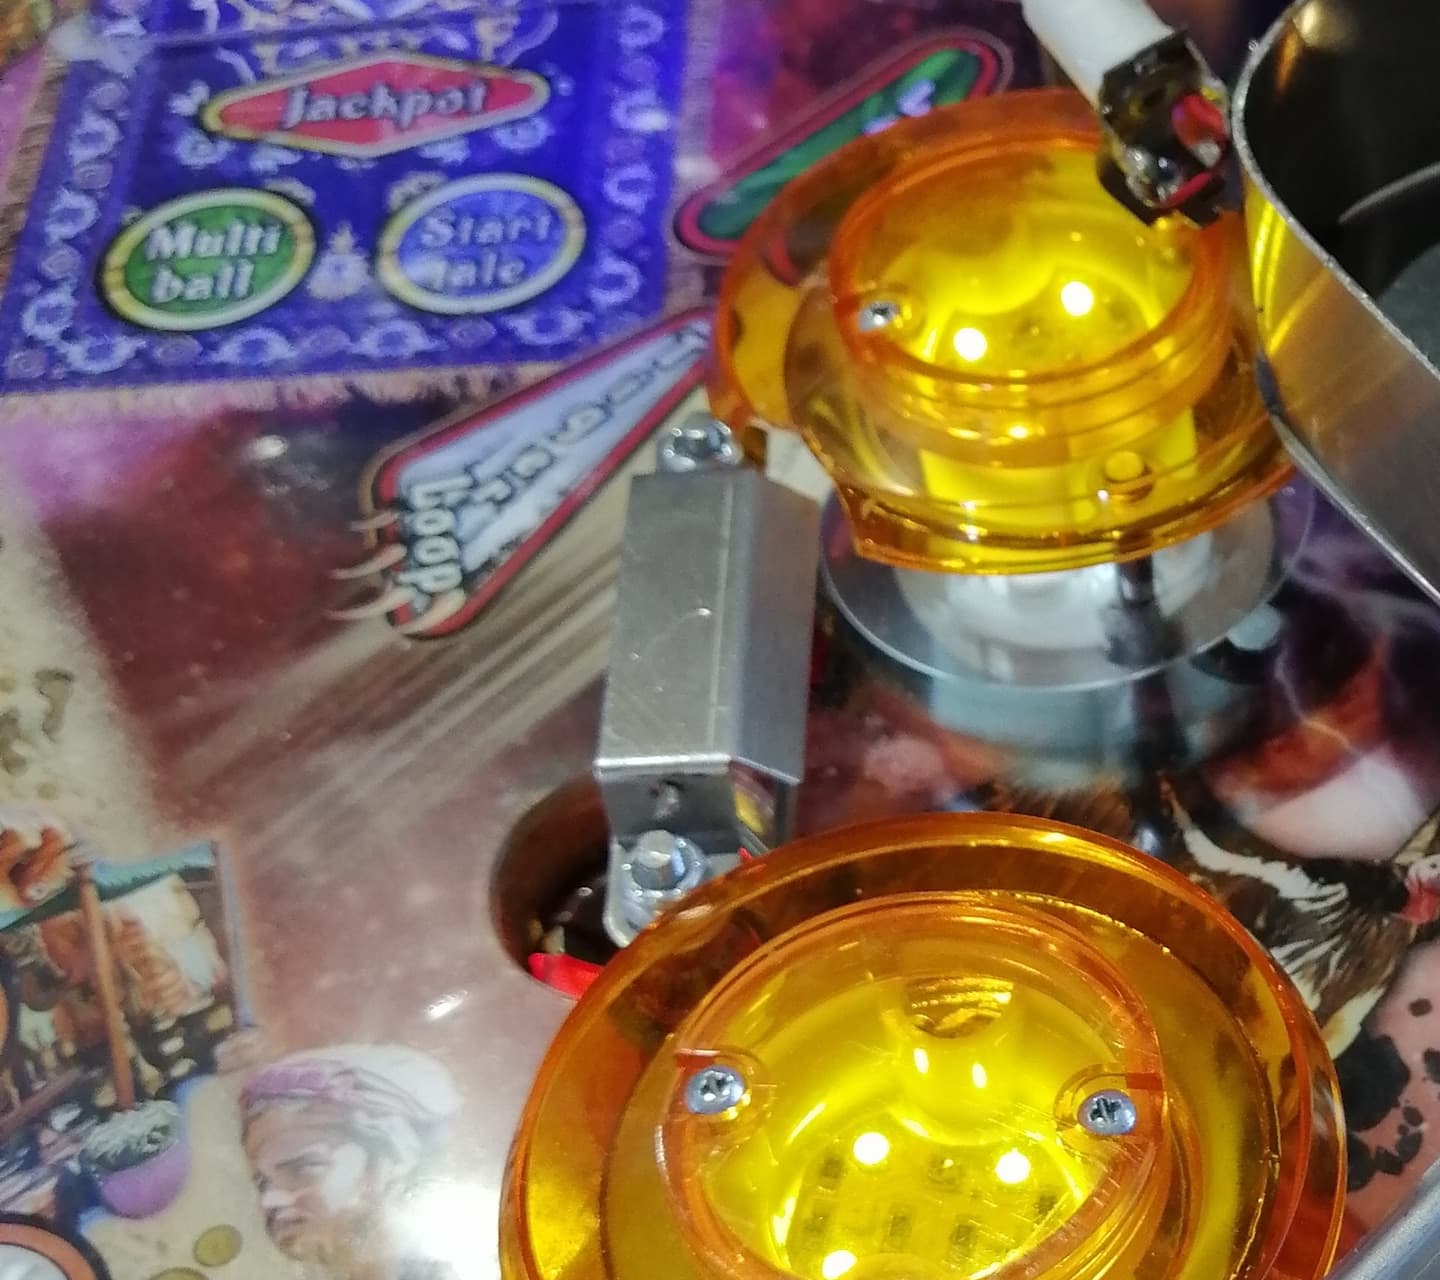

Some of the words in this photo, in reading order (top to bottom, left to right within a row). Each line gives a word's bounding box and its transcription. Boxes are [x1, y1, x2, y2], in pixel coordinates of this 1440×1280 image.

[284, 79, 488, 130] Jackpot
[145, 219, 281, 260] Multi
[420, 213, 552, 248] Start
[152, 258, 254, 303] ball
[393, 473, 475, 595] Loop
